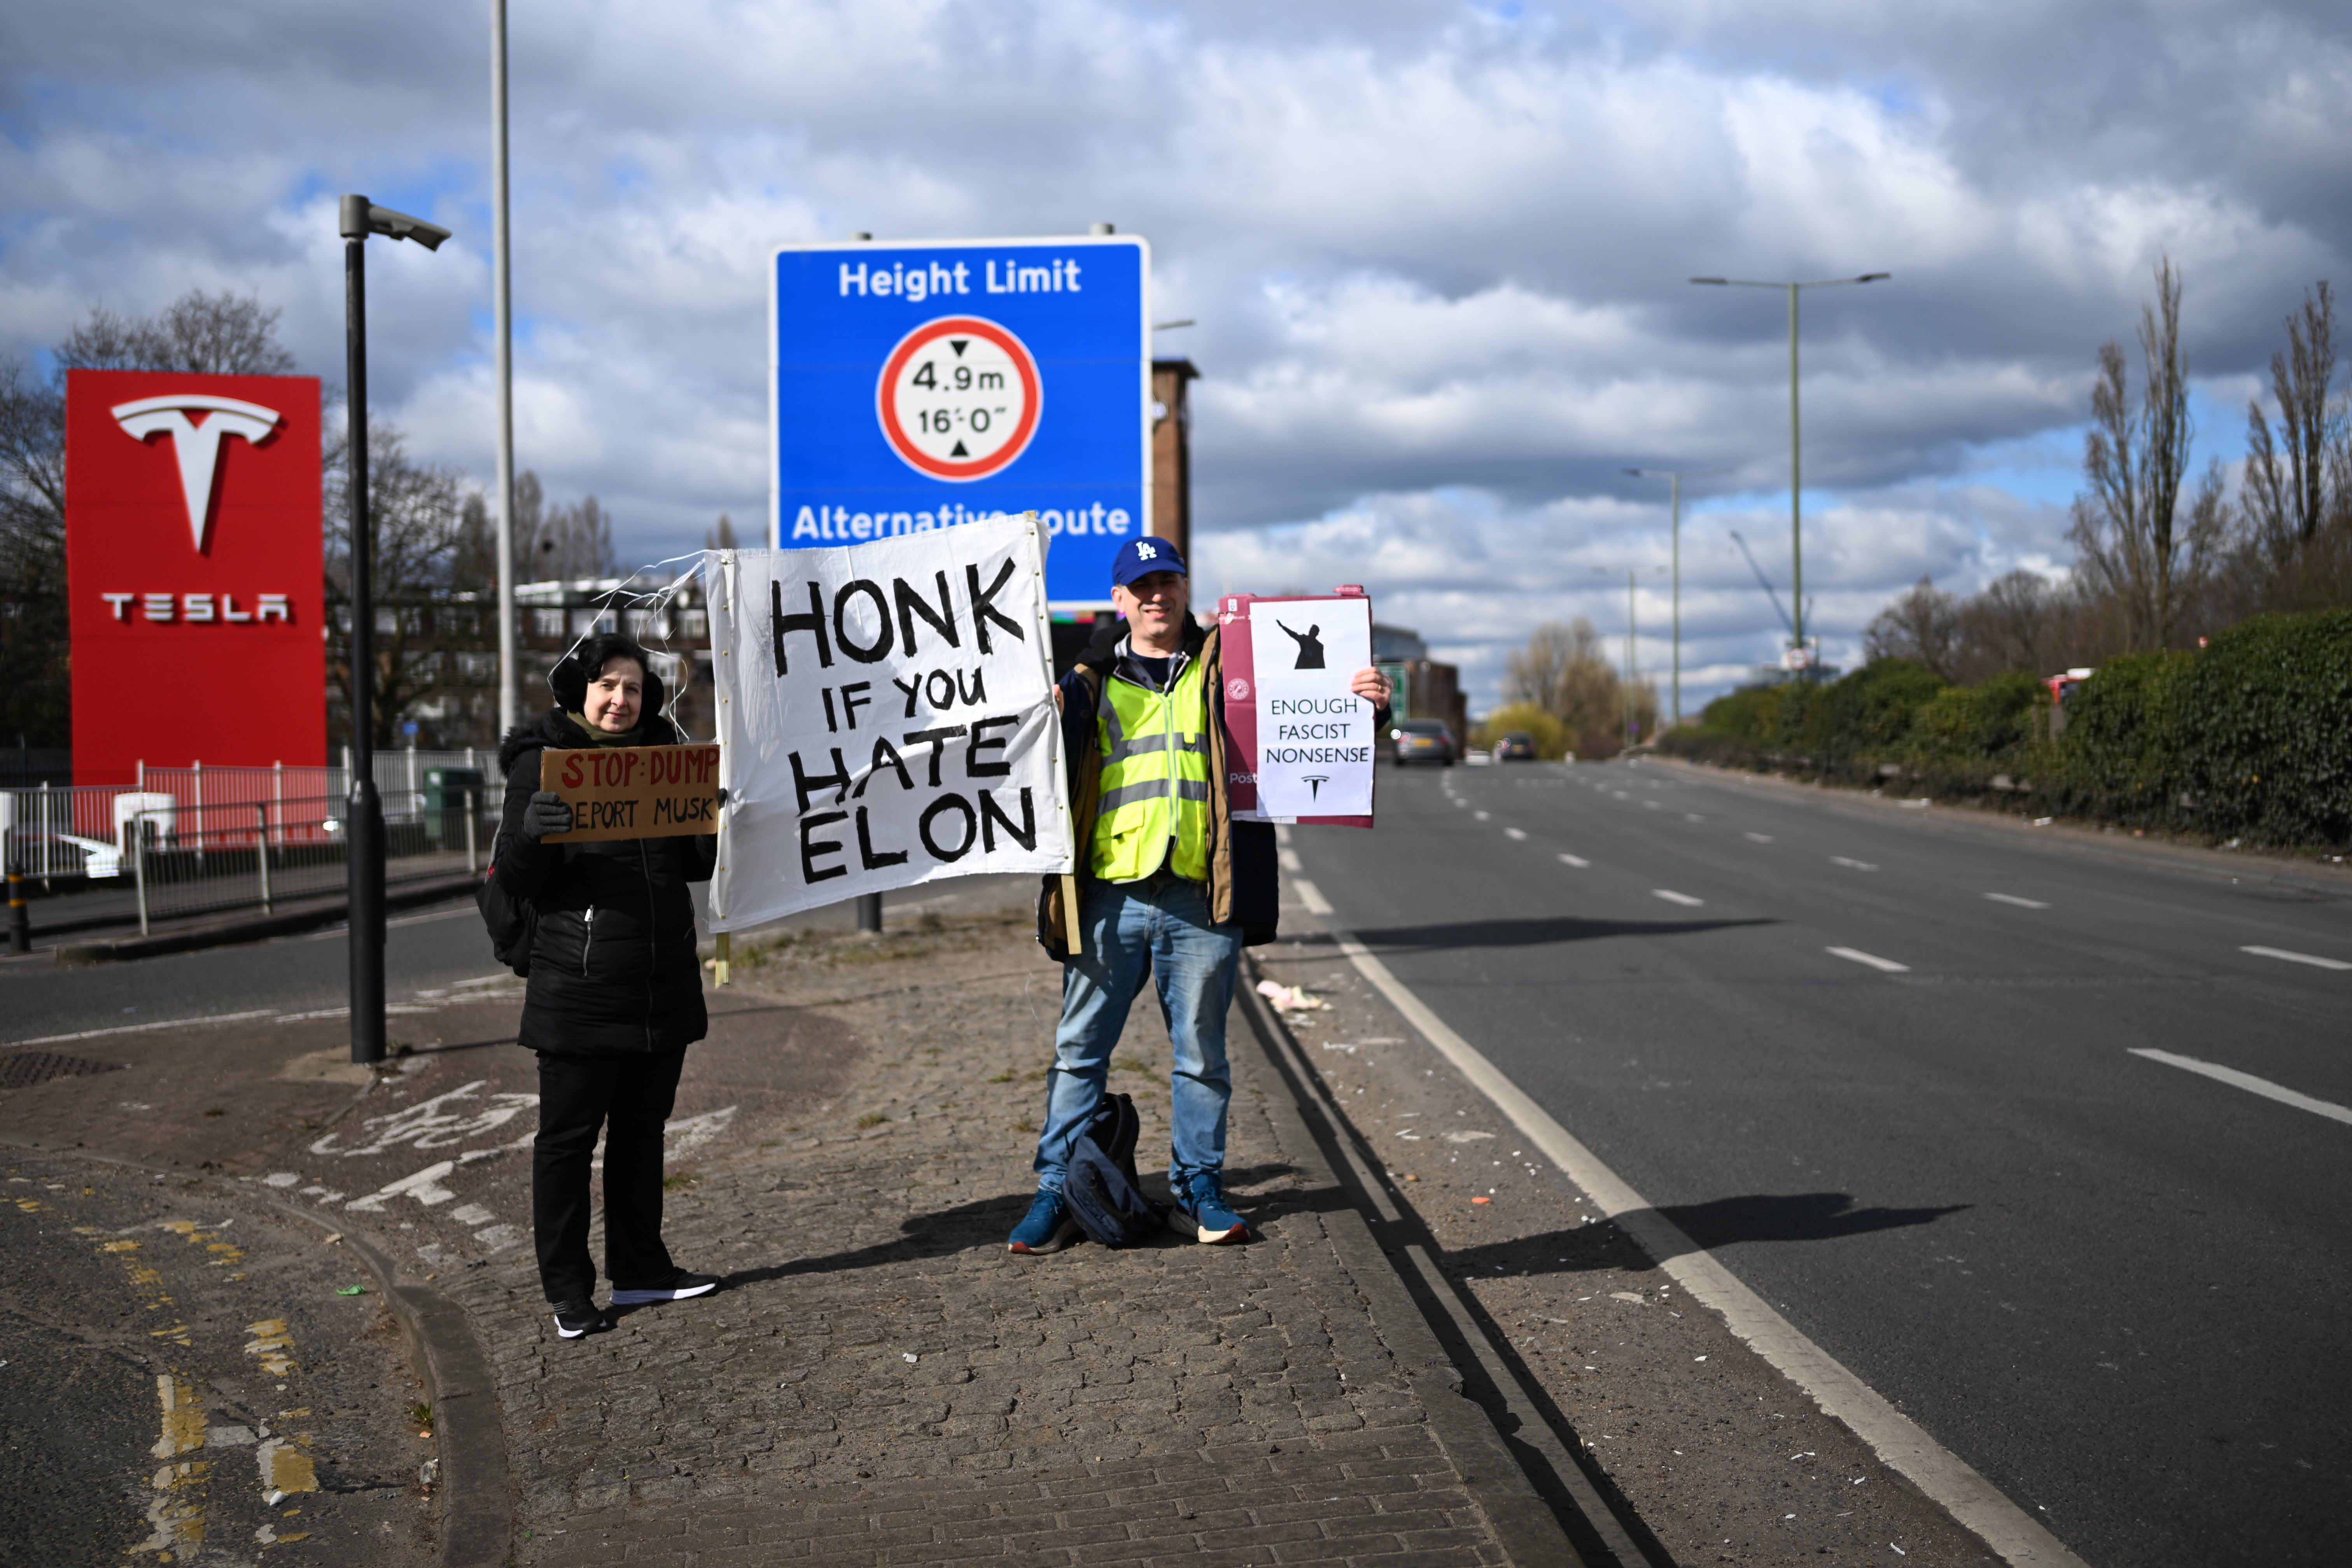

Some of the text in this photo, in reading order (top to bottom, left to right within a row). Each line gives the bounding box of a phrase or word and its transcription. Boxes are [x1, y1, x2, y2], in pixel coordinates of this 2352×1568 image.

[840, 259, 1081, 302] Height Limit
[1036, 502, 1130, 535] oute
[1136, 541, 1157, 561] LA
[102, 592, 288, 621] TESLA
[772, 557, 1024, 678] HONK
[822, 667, 987, 733] IF YOU
[1272, 698, 1357, 715] ENOUGH
[1279, 723, 1351, 739] FASCIST
[788, 714, 1020, 817] HATE
[1267, 747, 1369, 763] NONSENSE
[570, 797, 714, 830] EPORT MUSK
[800, 787, 1037, 885] ELON
